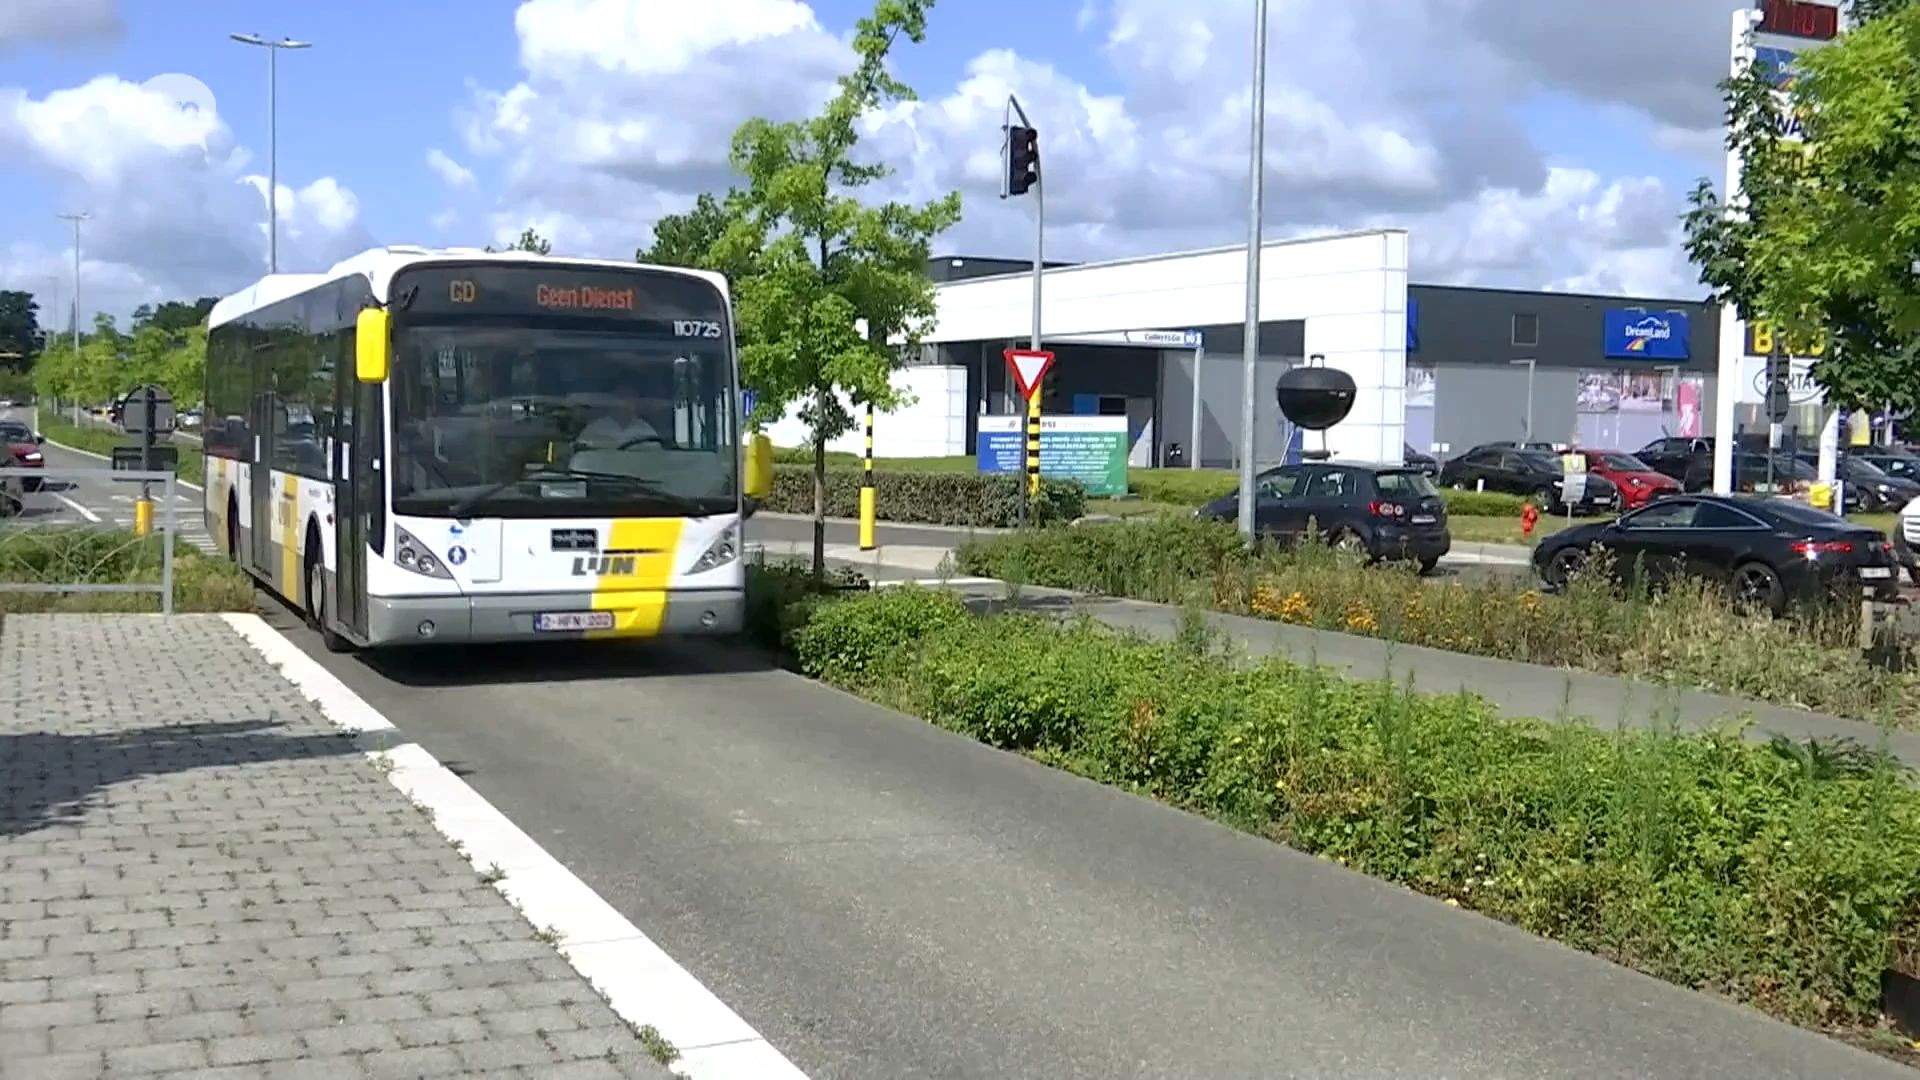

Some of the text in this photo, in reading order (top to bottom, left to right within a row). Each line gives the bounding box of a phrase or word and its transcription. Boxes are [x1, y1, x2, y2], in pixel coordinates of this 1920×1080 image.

[449, 280, 476, 303] GD
[537, 284, 634, 310] Geen Dienst
[673, 320, 722, 338] 110725
[1625, 325, 1671, 340] DreamLand
